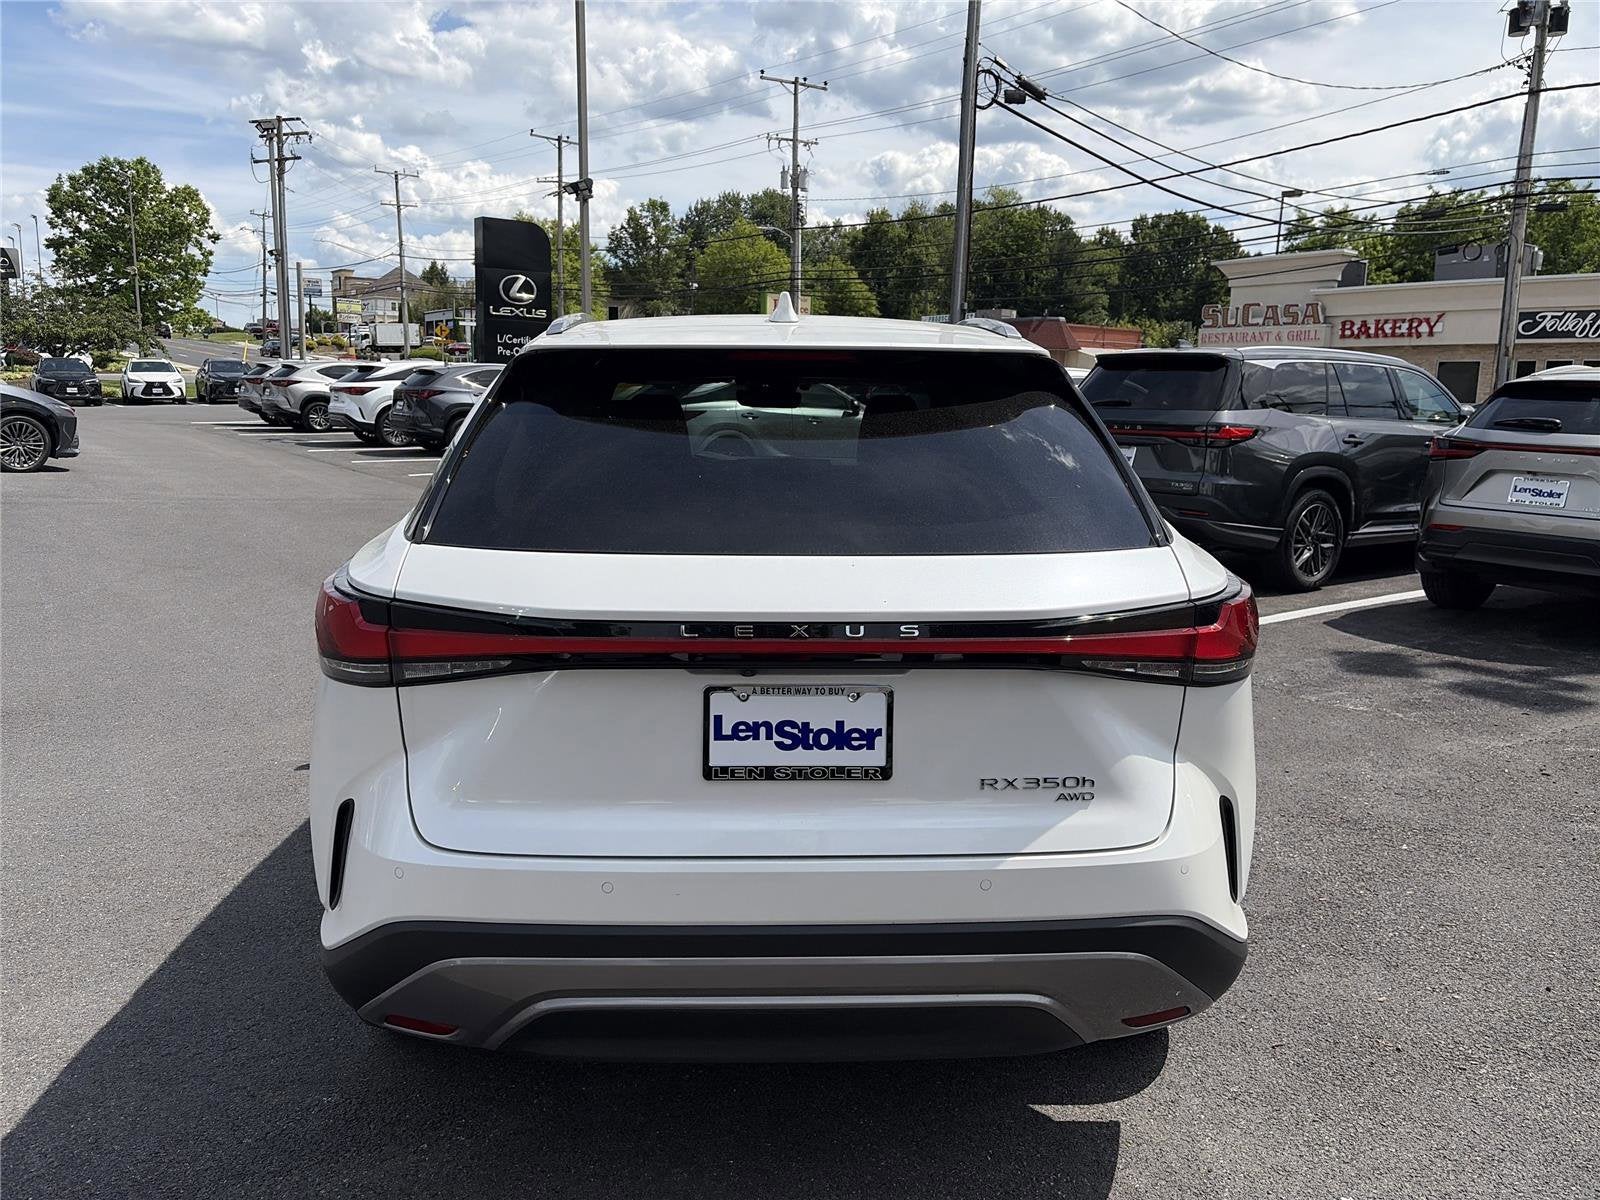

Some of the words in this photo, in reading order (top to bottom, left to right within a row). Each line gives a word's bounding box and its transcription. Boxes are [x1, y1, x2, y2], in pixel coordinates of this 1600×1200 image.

[489, 305, 547, 318] LEXUS
[1339, 313, 1445, 339] BAKERY
[1200, 331, 1272, 344] RESTAURANT
[1274, 331, 1281, 342] &
[1287, 329, 1320, 342] GRILL
[497, 346, 521, 356] Pre-O
[680, 624, 919, 637] LEXUS
[751, 687, 758, 695] A
[760, 687, 792, 695] BETTER
[794, 687, 812, 695] WAY
[814, 687, 826, 695] TO
[828, 687, 846, 695] BUY
[713, 714, 882, 751] LenStoler
[712, 766, 766, 780] LEN
[773, 766, 882, 780] STOLER
[979, 776, 1095, 791] RX350h
[1055, 791, 1095, 802] AWD
